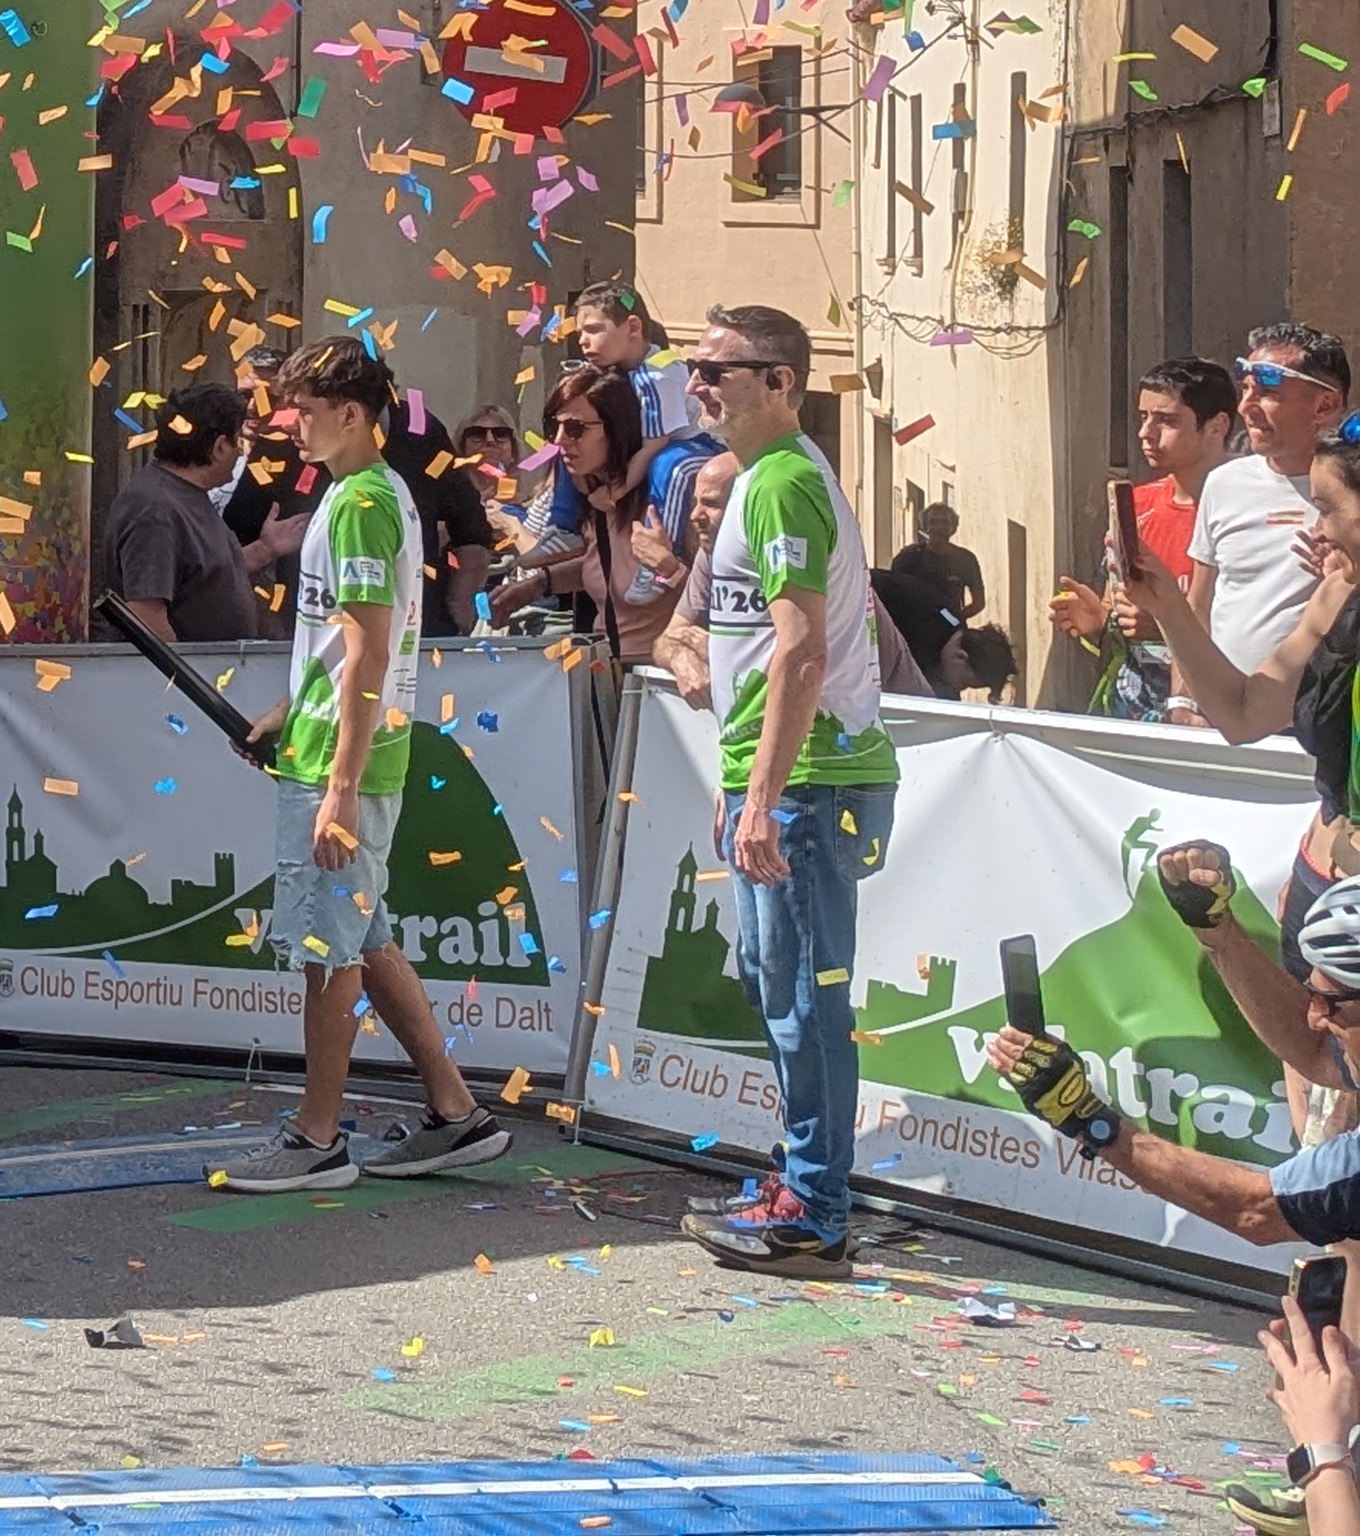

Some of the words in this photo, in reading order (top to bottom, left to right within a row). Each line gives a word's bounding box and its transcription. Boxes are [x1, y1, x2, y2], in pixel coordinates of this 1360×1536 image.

[20, 966, 75, 999] Club
[83, 970, 183, 1010] Esportiu
[192, 977, 303, 1016] Fondiste
[447, 994, 483, 1027] de
[494, 996, 554, 1032] Dalt
[658, 1054, 729, 1099] Club
[878, 1099, 1041, 1170] Fondistes
